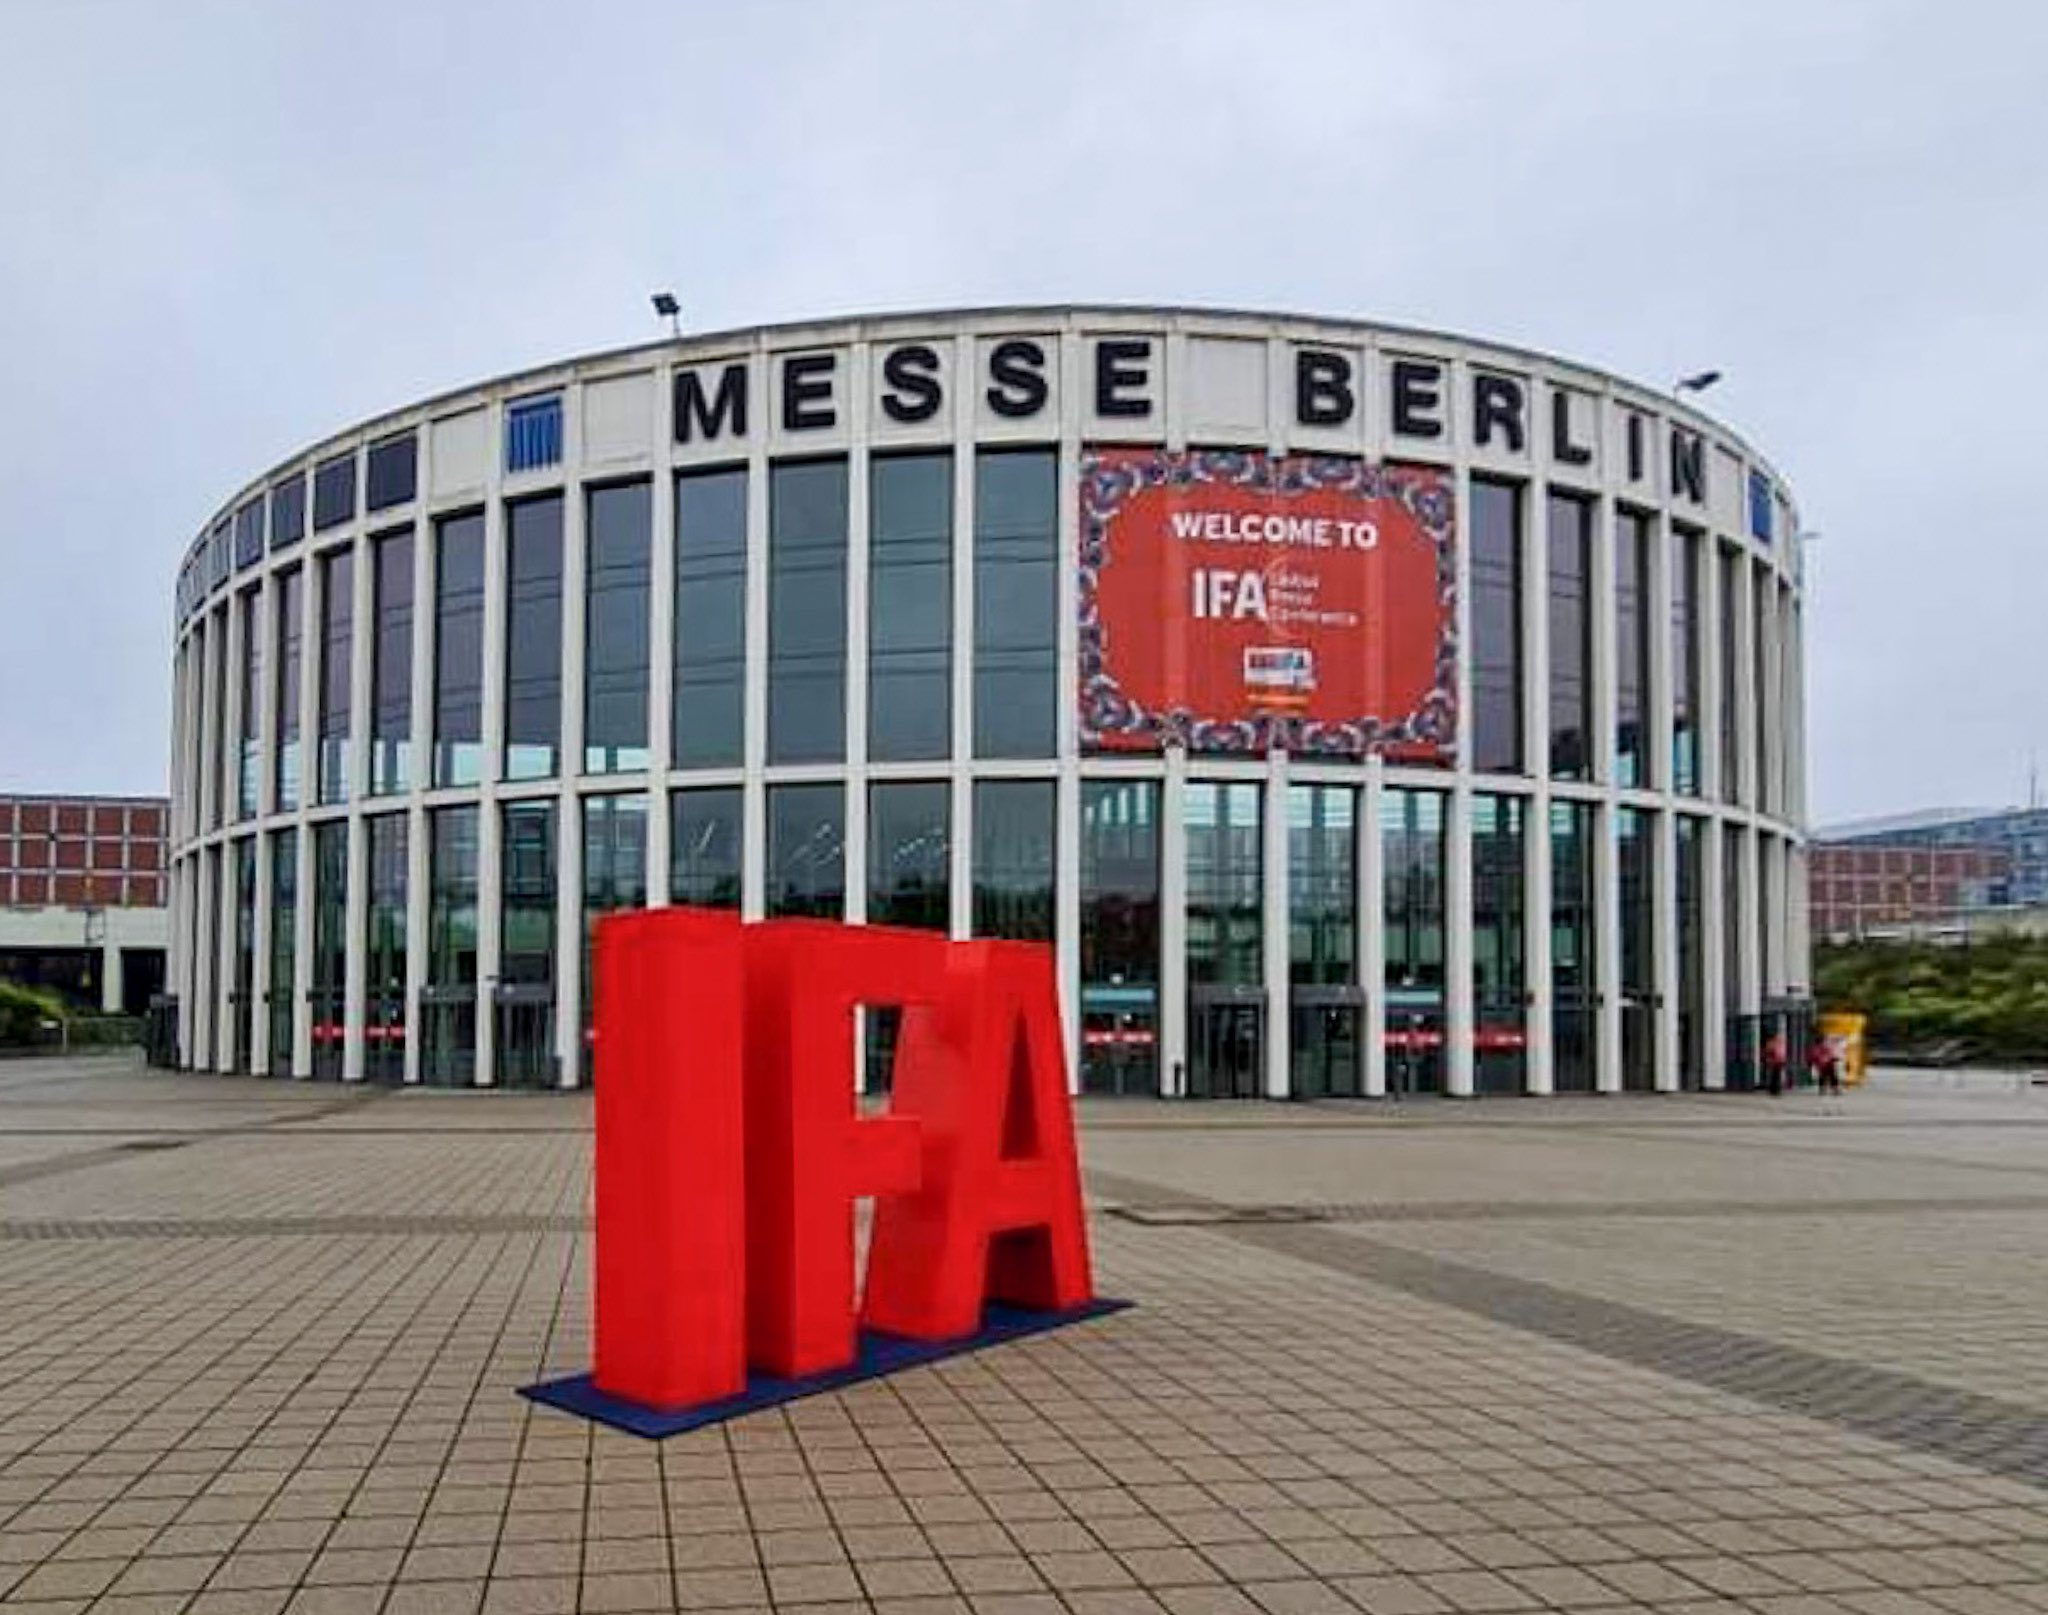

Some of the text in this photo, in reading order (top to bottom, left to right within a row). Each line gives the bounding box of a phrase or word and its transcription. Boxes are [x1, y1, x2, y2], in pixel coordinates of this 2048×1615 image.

[672, 339, 1705, 503] MESSE BERLIN
[1170, 511, 1379, 549] WELCOME TO
[1192, 567, 1269, 620] IFA
[593, 906, 1093, 1412] IFA
